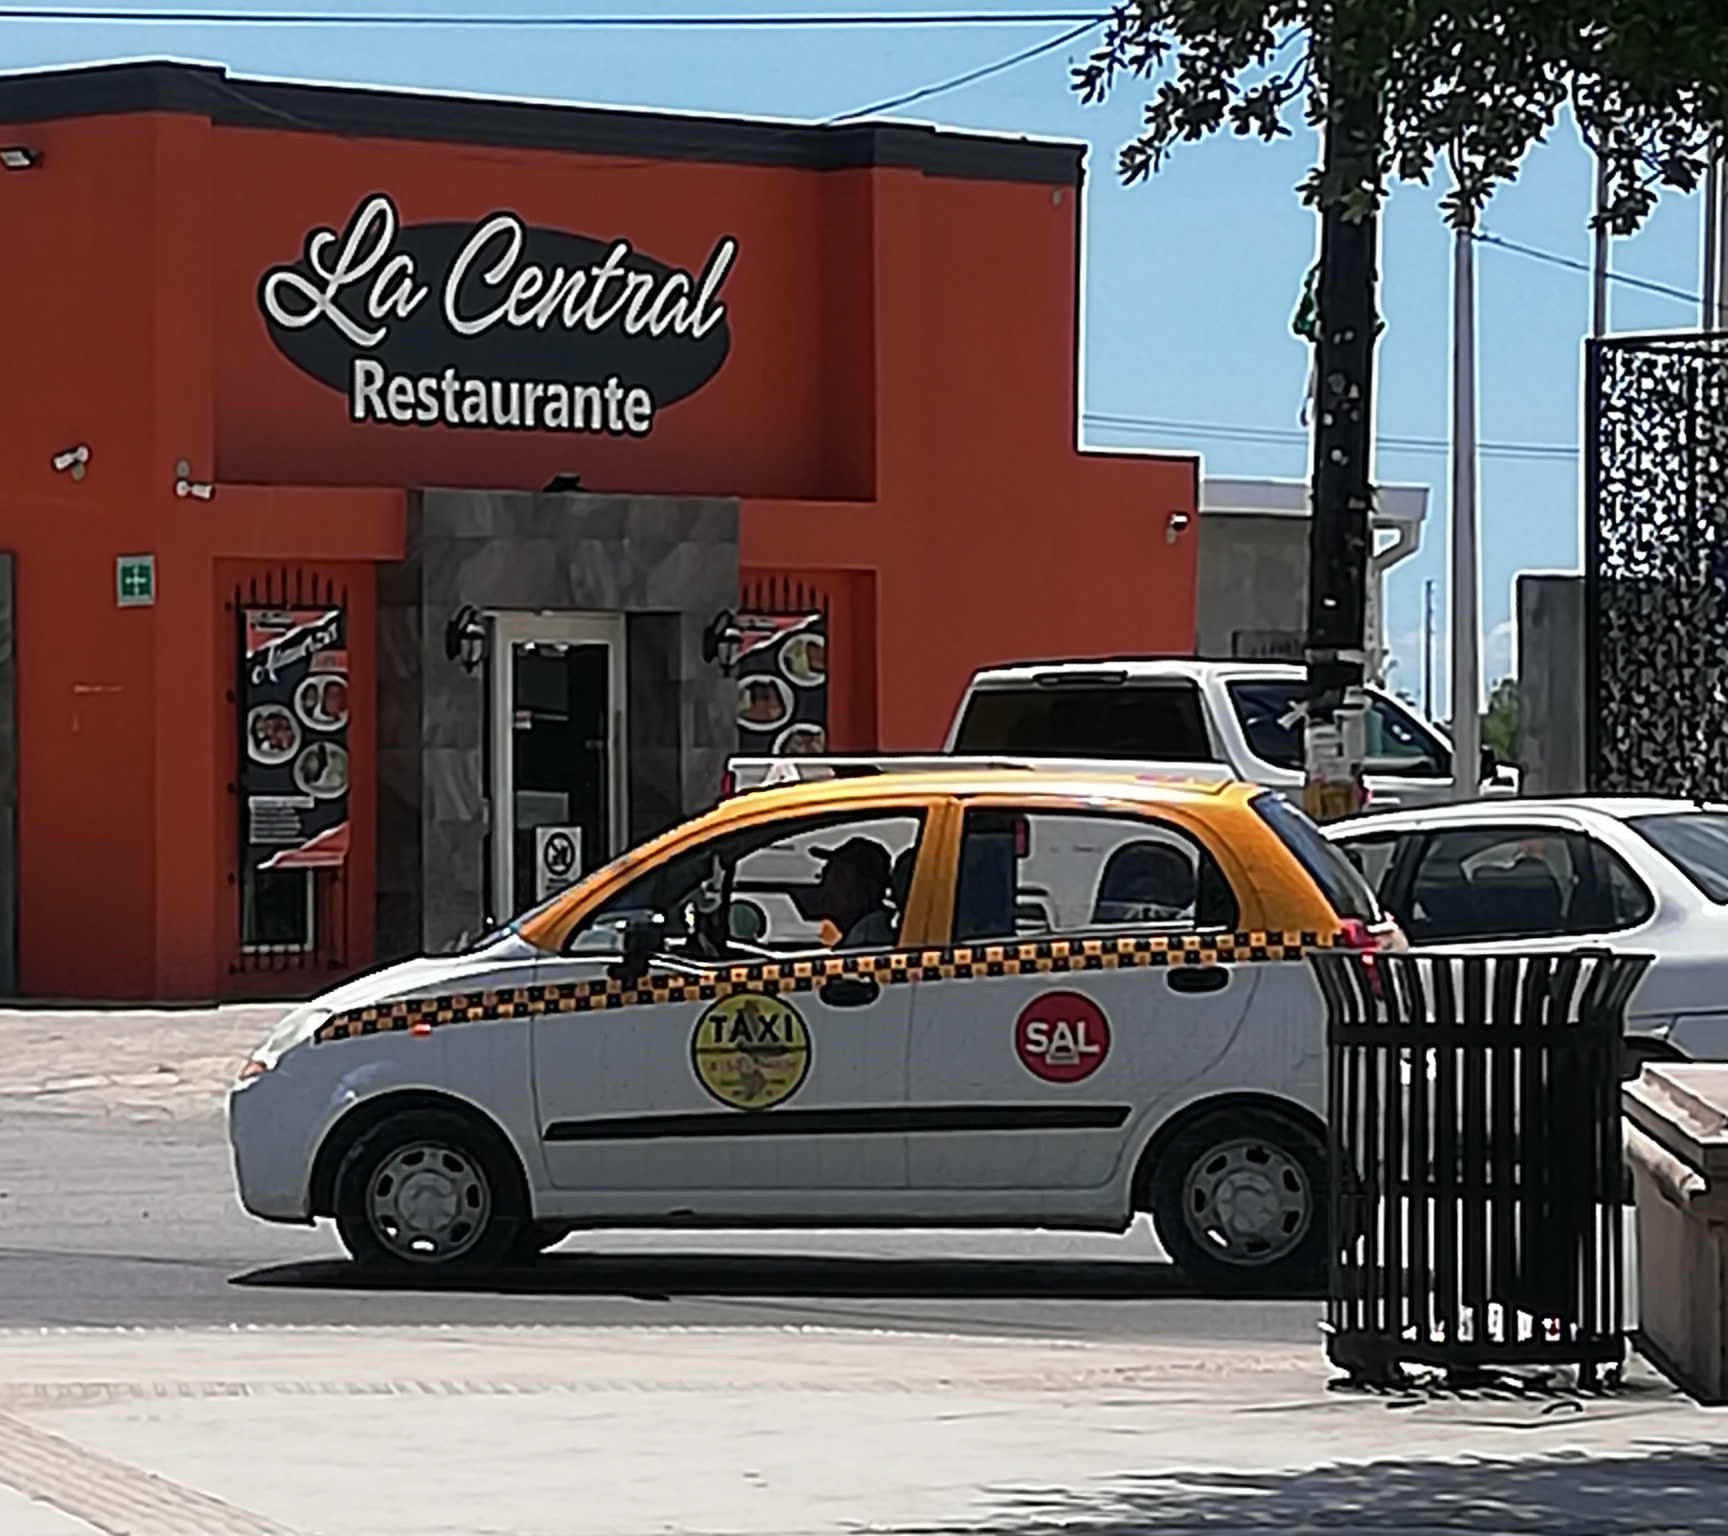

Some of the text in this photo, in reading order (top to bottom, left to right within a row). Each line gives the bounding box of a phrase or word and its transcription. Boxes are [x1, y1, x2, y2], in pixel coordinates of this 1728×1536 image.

[265, 198, 737, 347] La Central
[353, 359, 652, 432] Restaurante
[708, 1008, 794, 1044] TAXI
[1025, 1020, 1101, 1055] SAL
